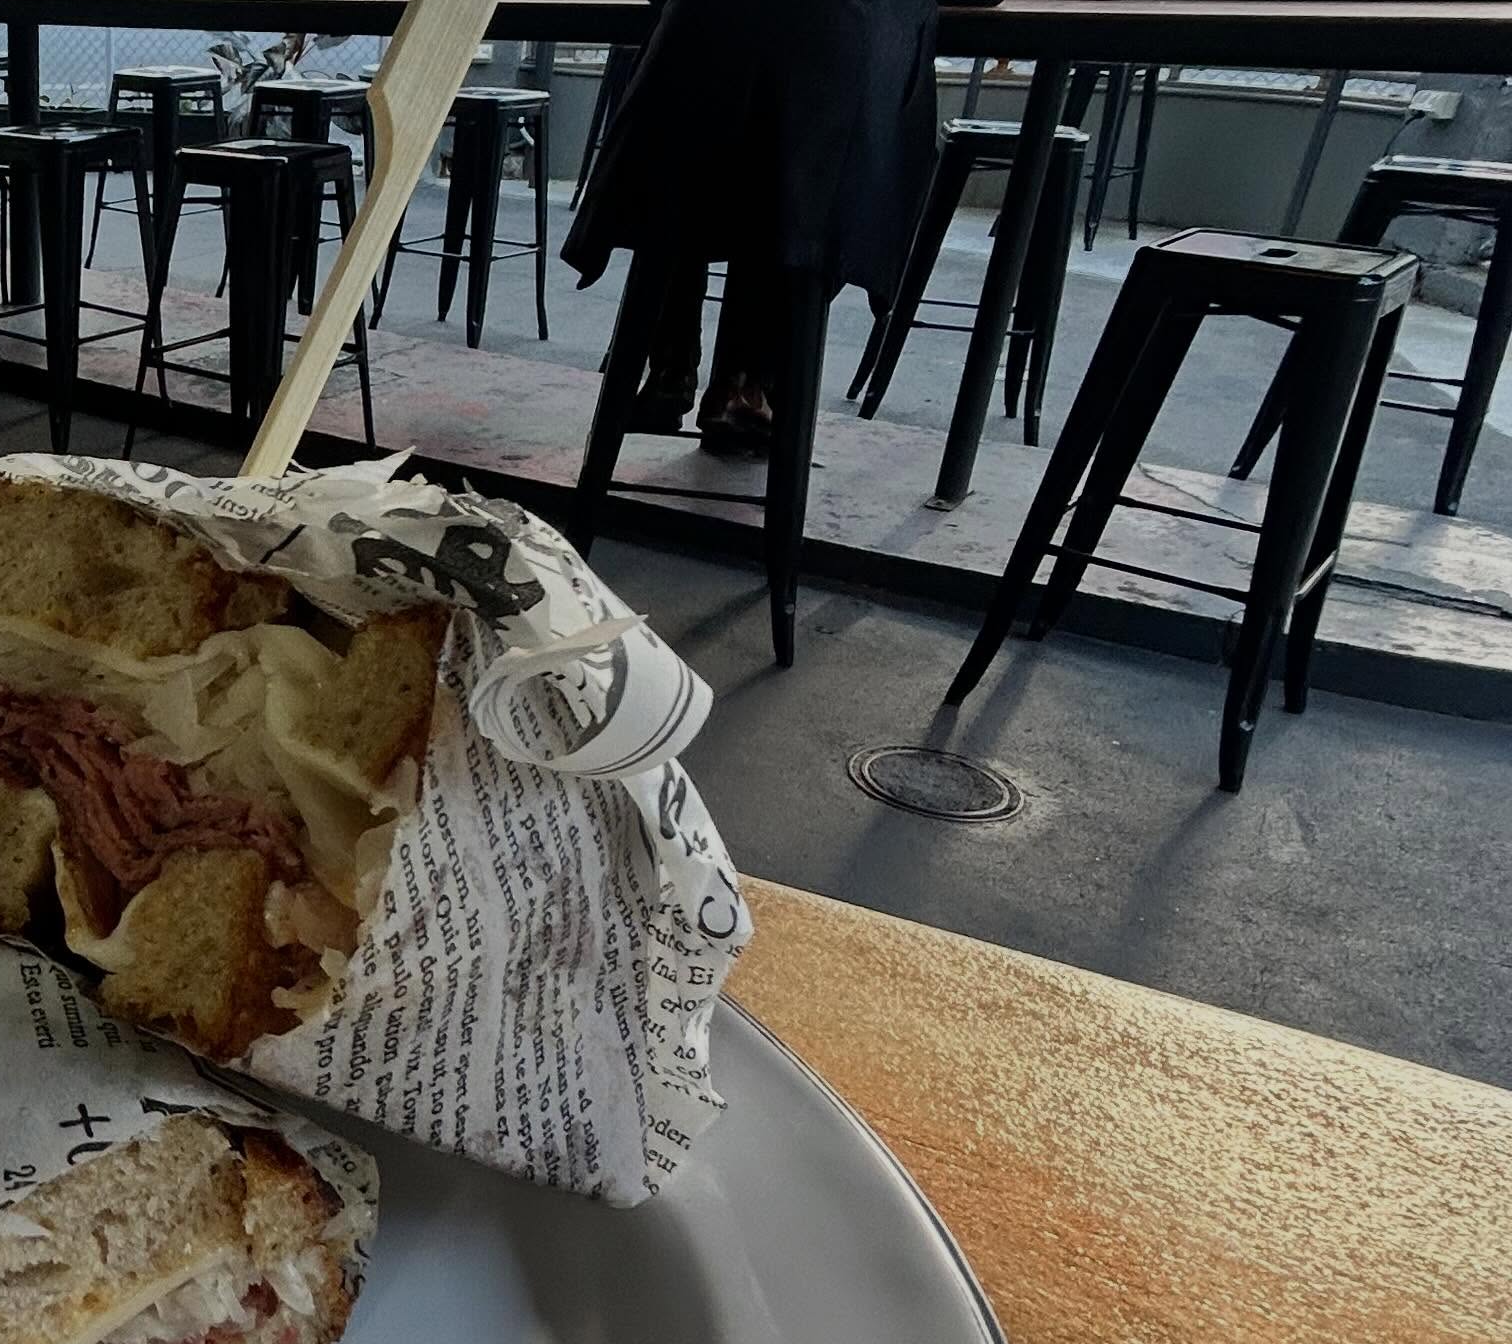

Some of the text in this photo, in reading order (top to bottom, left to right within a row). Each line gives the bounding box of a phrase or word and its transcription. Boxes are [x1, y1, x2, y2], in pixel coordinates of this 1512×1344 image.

[400, 843, 431, 952] omnium
[432, 794, 471, 910] nostrum,
[466, 909, 483, 951] his
[315, 1035, 336, 1068] pro
[383, 1006, 406, 1065] tation
